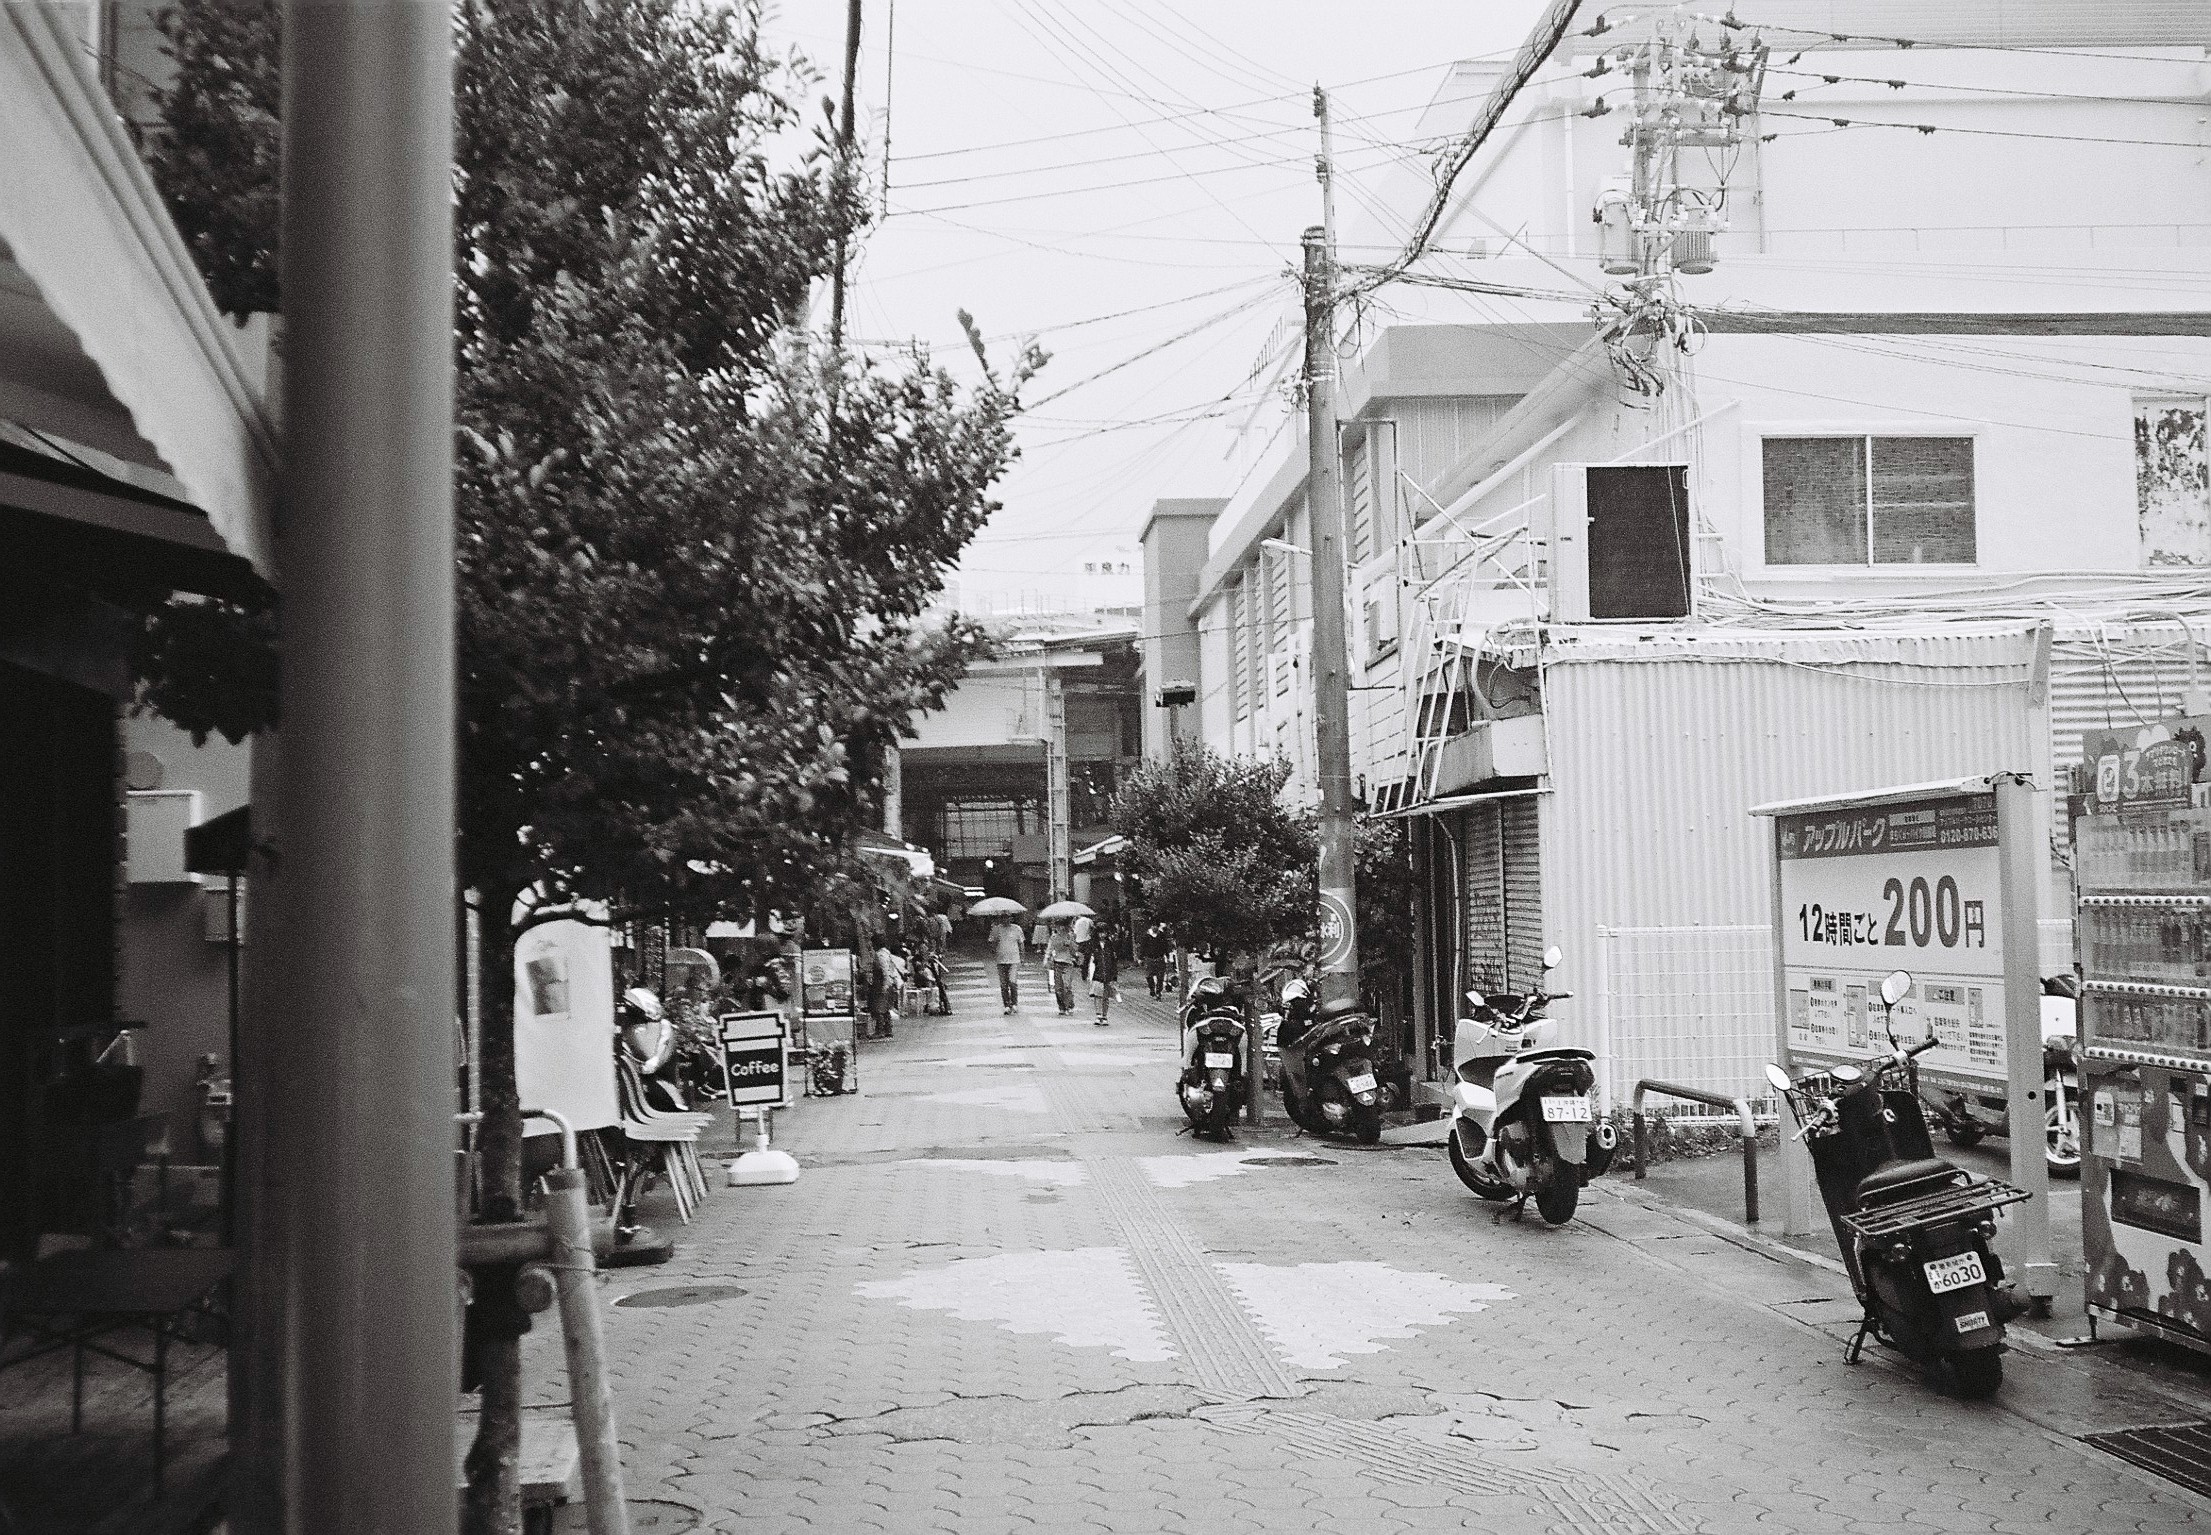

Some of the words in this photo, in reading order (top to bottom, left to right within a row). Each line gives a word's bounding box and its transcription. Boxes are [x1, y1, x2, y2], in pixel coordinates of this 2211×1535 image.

[1802, 816, 1886, 852] アップルパーク
[1799, 903, 1879, 947] 12時間ごと
[1883, 875, 1985, 949] 200円
[731, 1060, 780, 1077] Coffee
[1547, 1107, 1588, 1120] 87-12
[1942, 1263, 1982, 1288] 6030
